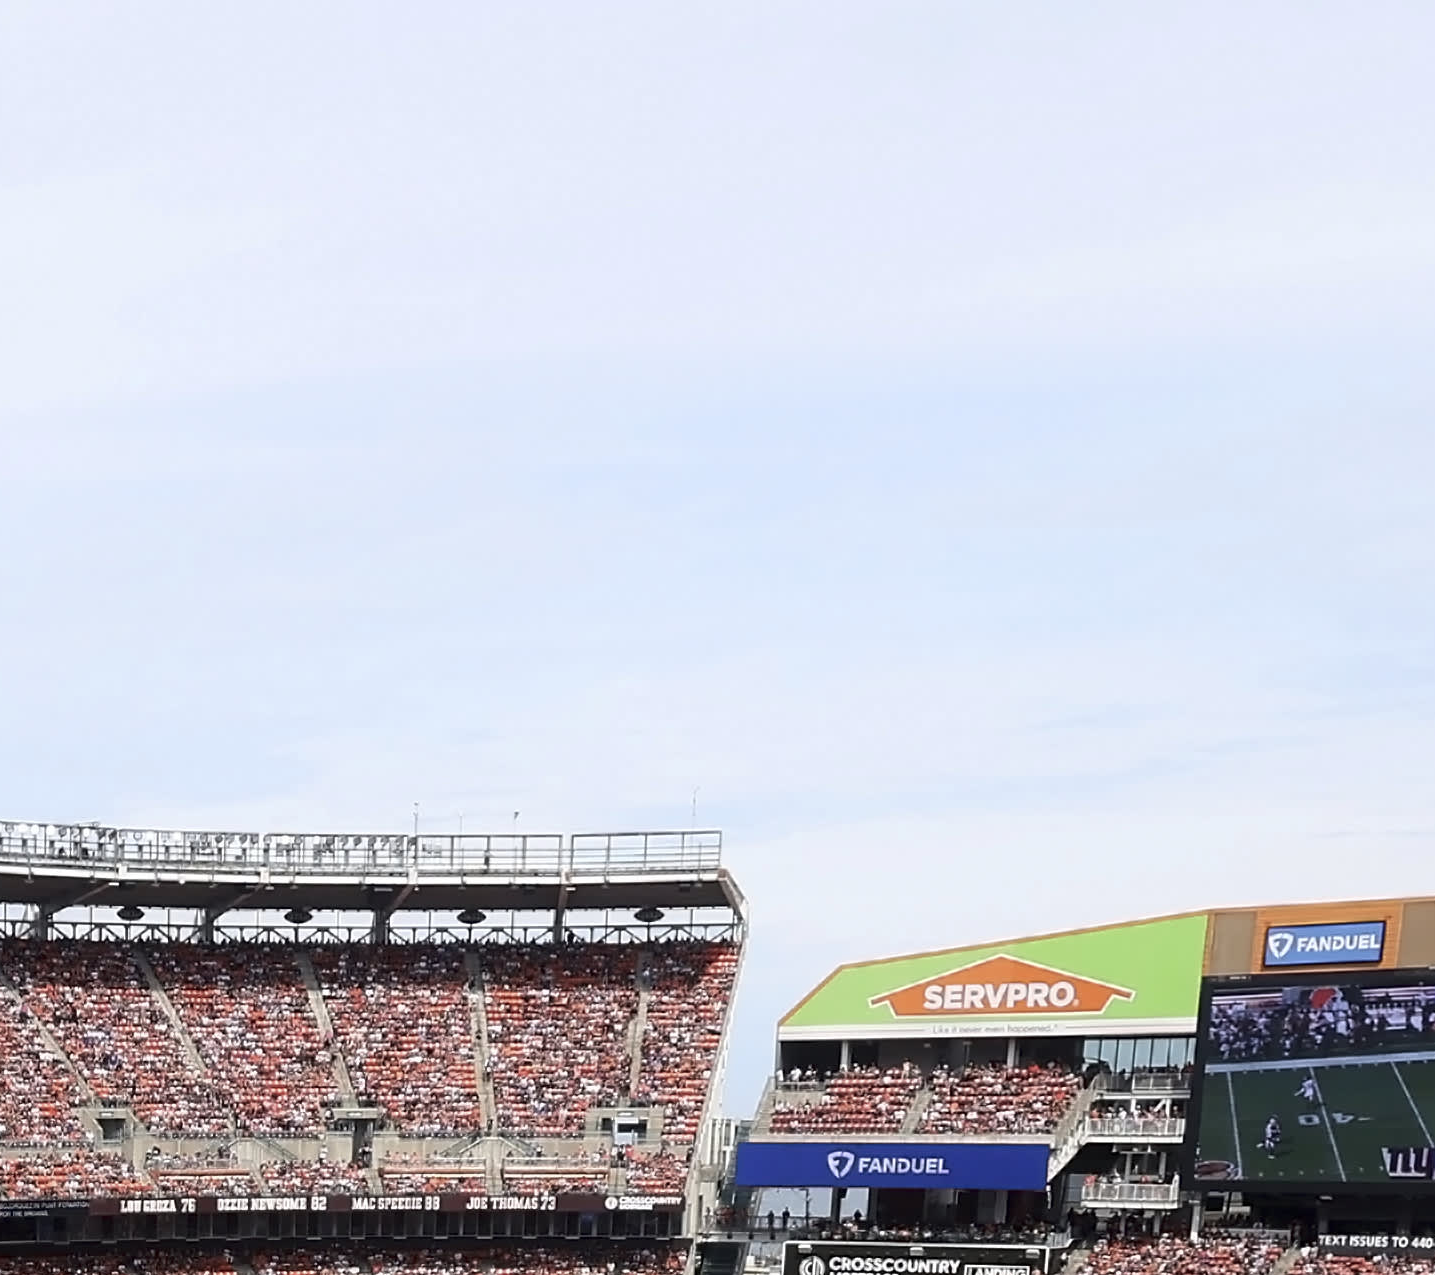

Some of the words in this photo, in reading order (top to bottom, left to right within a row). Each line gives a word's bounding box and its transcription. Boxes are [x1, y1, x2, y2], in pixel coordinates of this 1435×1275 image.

[1297, 934, 1380, 952] FANDUEL
[923, 982, 1074, 1010] SERVPRO
[858, 1157, 949, 1174] FANDUEL
[120, 1199, 142, 1213] LOU
[143, 1199, 176, 1213] GROZA
[180, 1198, 196, 1212] 76
[217, 1198, 248, 1210] OZZIE
[250, 1197, 307, 1210] NEWSOME
[311, 1196, 327, 1209] 82
[352, 1197, 376, 1210] MAC
[377, 1197, 422, 1210] SPEEDIE
[466, 1197, 488, 1209] JOE
[490, 1197, 538, 1209] THOMAS
[540, 1196, 556, 1209] 73
[1319, 1235, 1347, 1245] TEXT
[1349, 1236, 1389, 1247] ISSUES
[1391, 1237, 1409, 1248] TO
[829, 1257, 960, 1275] CROSSCOUNTRY
